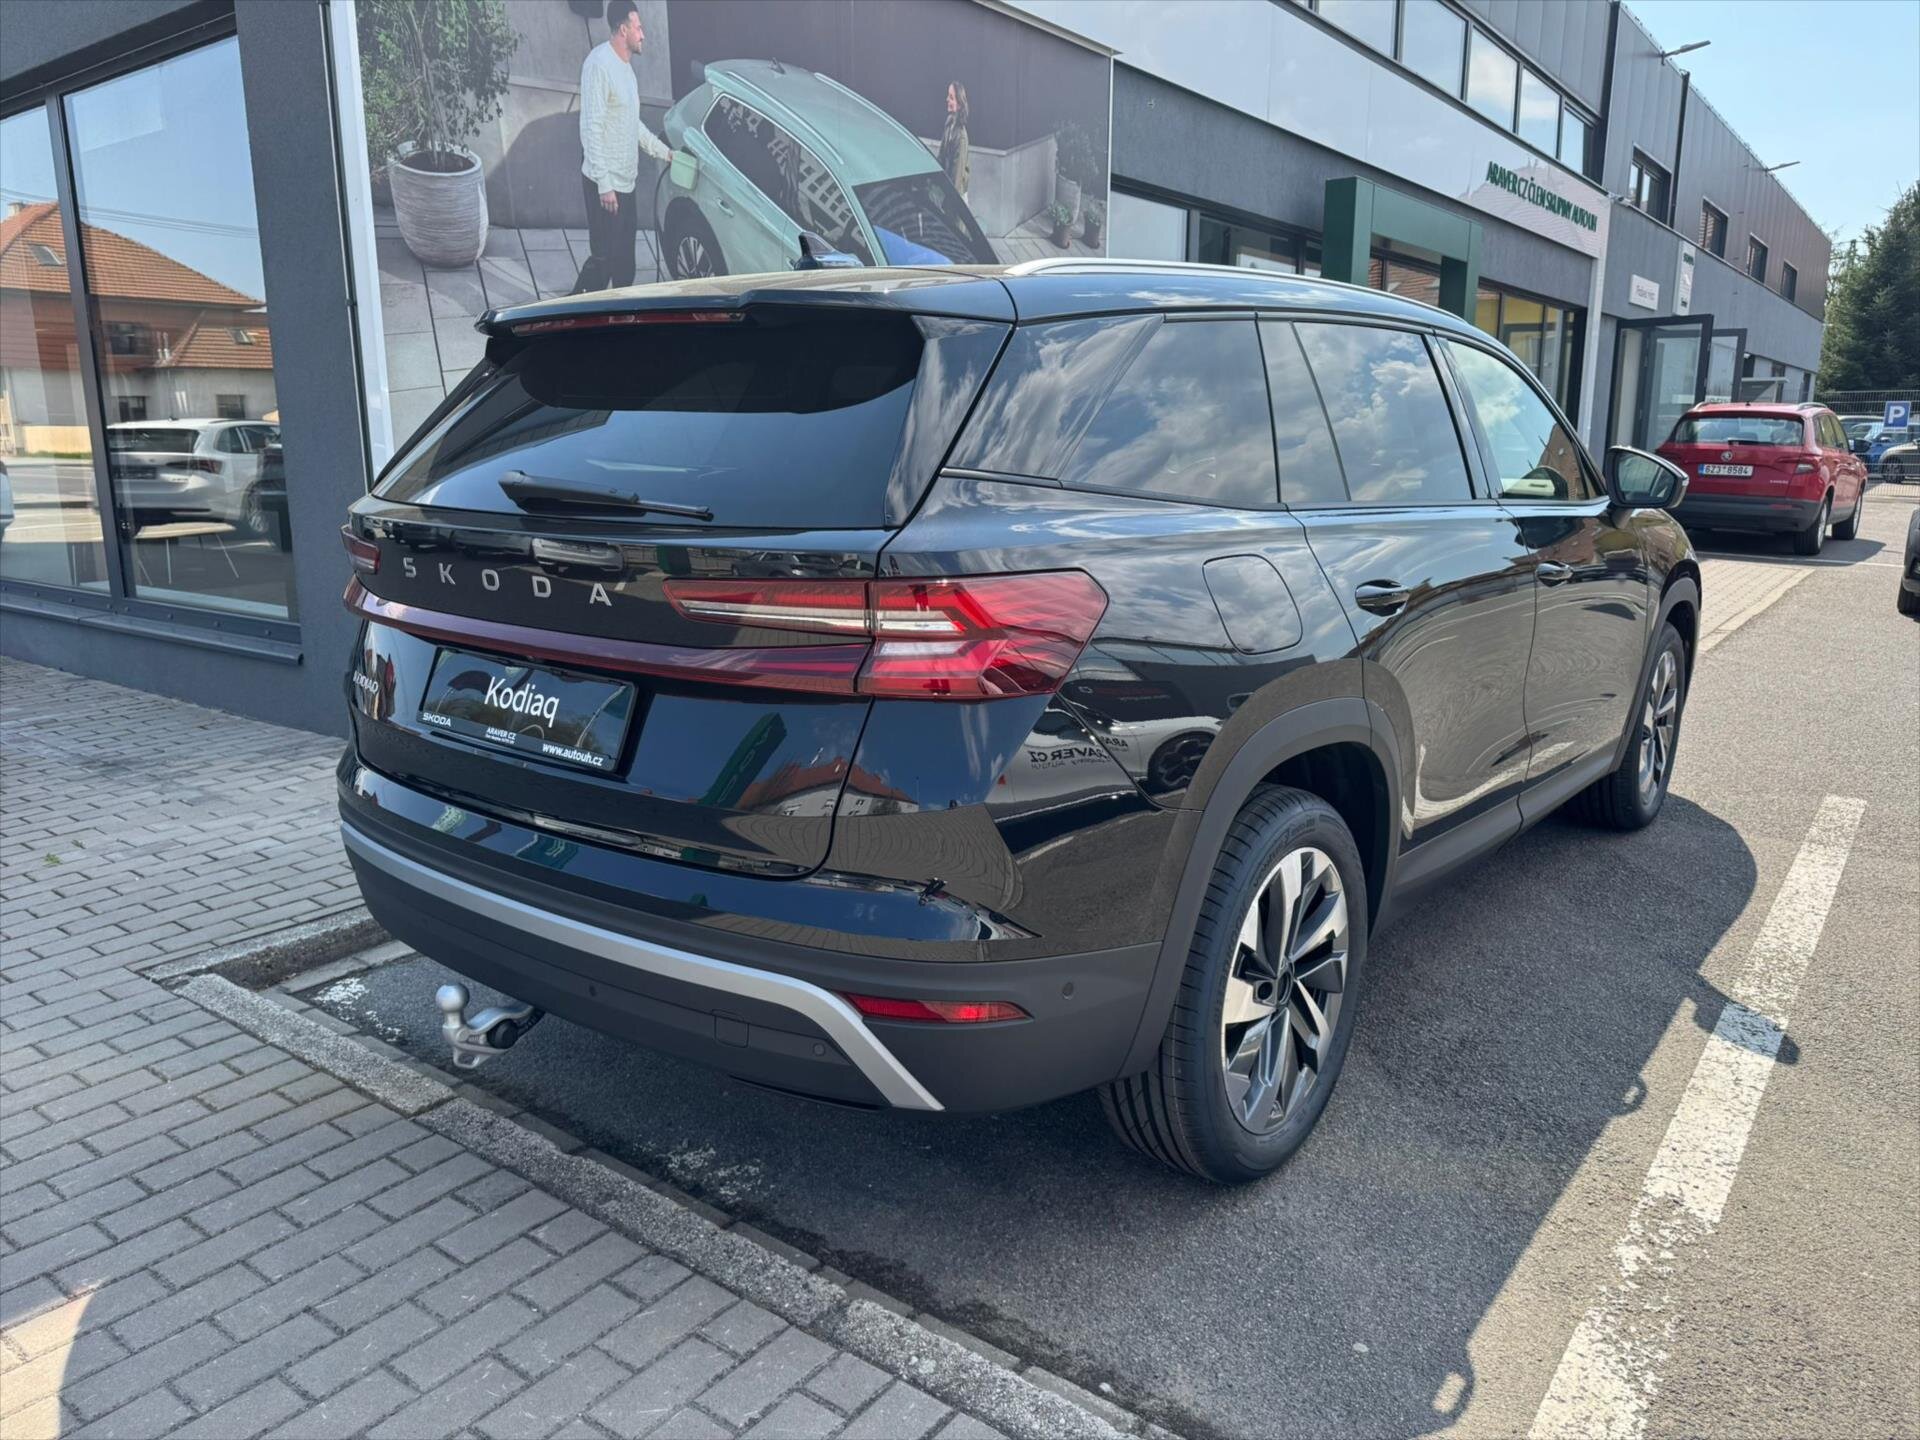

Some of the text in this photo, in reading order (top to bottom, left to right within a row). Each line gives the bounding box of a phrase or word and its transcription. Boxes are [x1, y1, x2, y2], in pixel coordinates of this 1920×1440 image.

[1486, 161, 1518, 195] ARAVER
[1518, 177, 1529, 199] CZ
[1888, 405, 1905, 424] P
[484, 676, 560, 728] Kodiaq
[486, 726, 508, 739] ARAVER
[507, 731, 517, 741] CZ
[542, 743, 604, 767] www.autouh.cz
